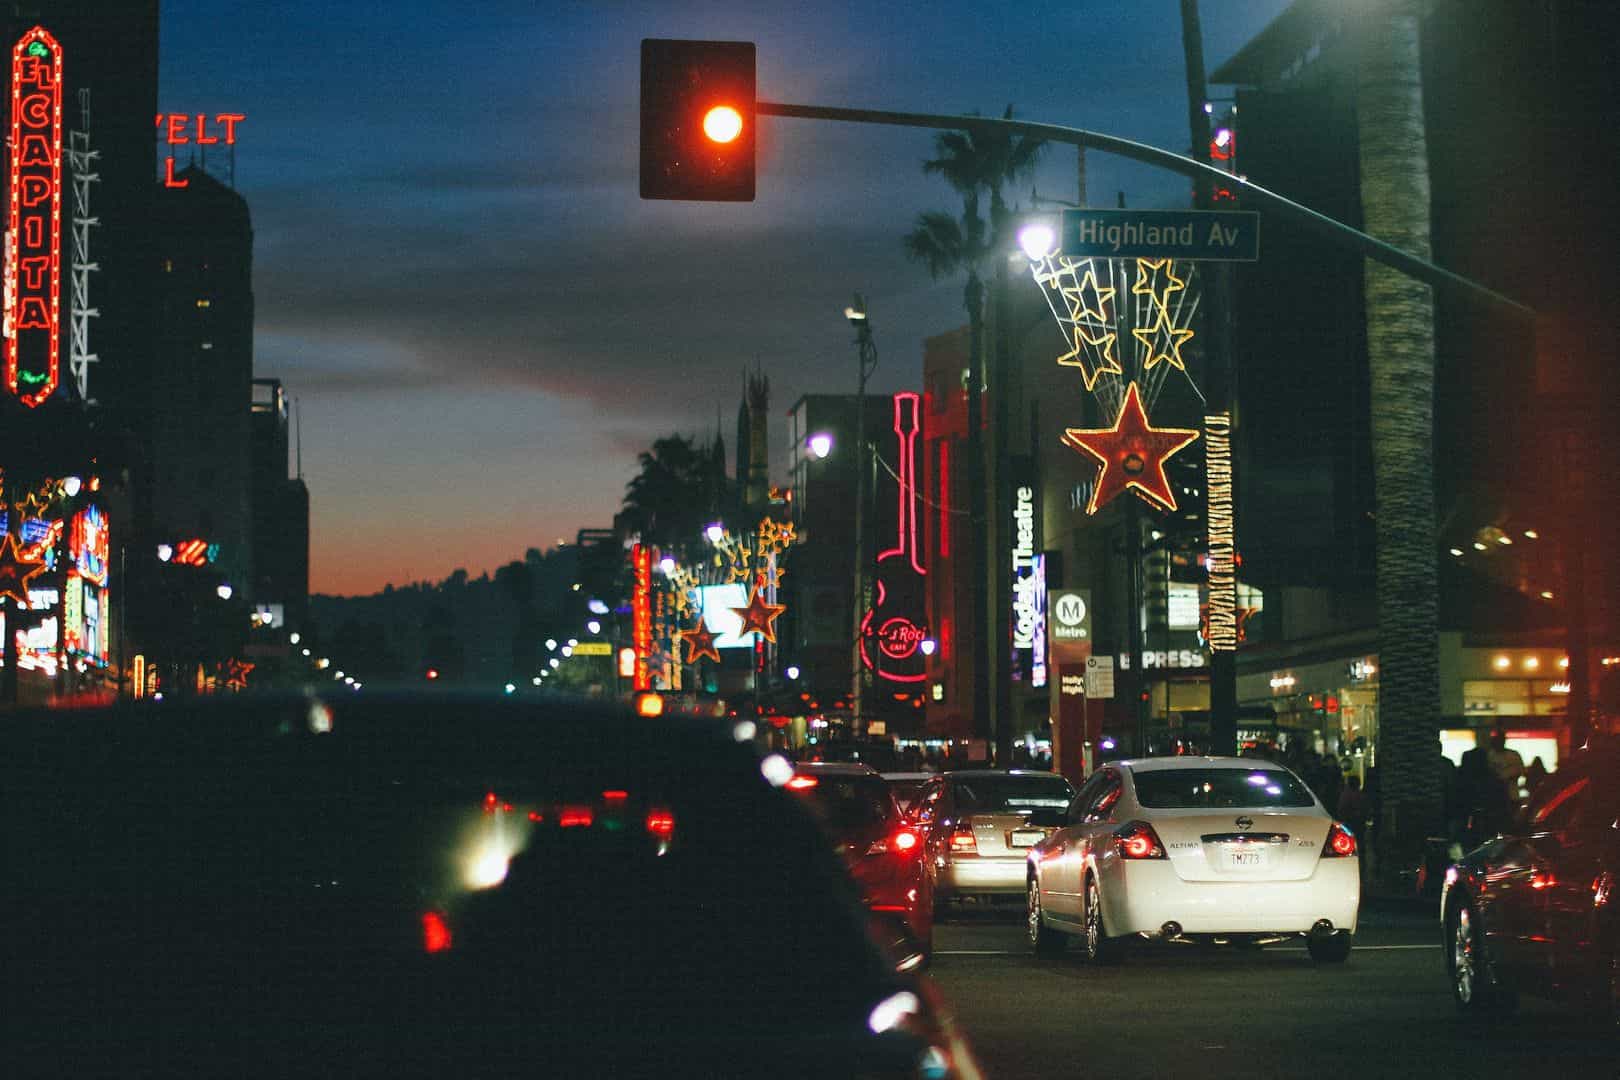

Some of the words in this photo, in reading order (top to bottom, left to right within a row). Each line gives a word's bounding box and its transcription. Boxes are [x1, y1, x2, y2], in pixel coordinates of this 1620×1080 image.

[20, 57, 55, 89] EL
[1078, 219, 1193, 251] Highland
[1207, 222, 1239, 246] Av
[1012, 487, 1034, 571] Theatre
[1013, 576, 1034, 649] Kodak
[1055, 627, 1087, 638] Metro
